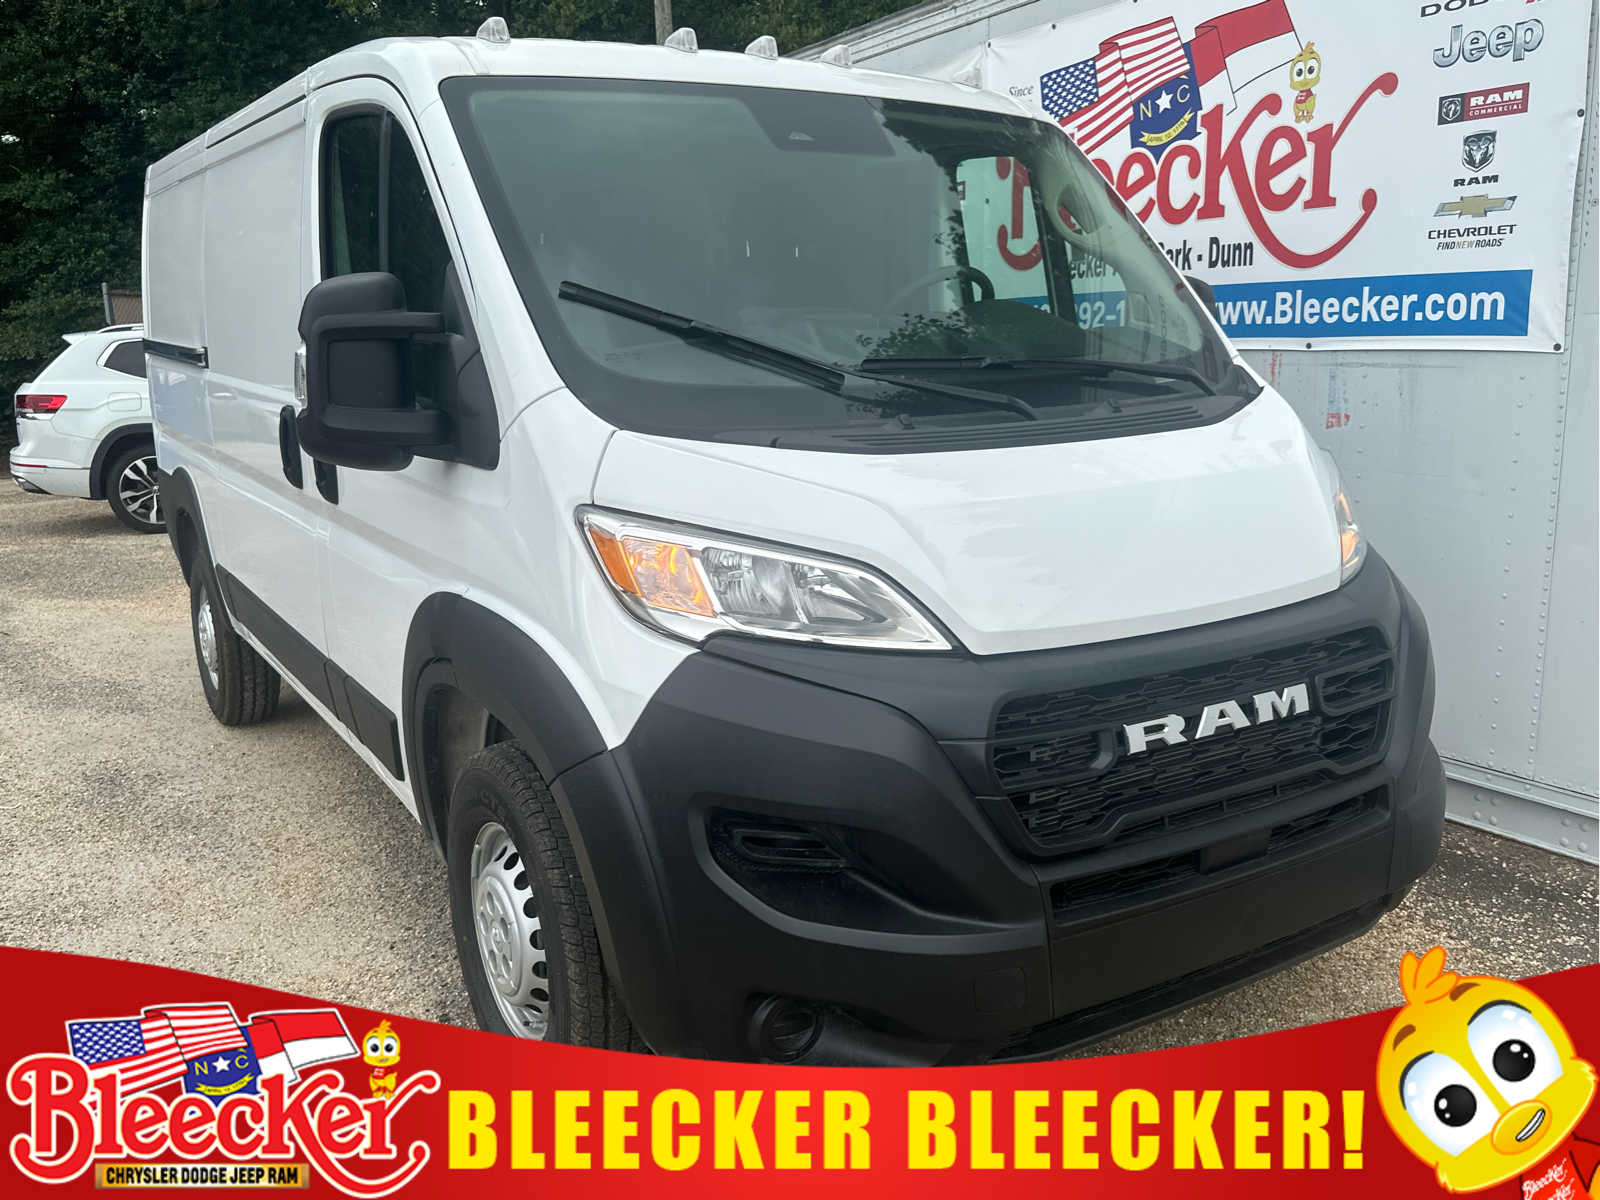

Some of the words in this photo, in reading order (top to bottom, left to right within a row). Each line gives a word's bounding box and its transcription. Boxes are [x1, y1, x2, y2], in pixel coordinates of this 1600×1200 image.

[1432, 18, 1544, 68] Jeep
[1009, 85, 1034, 96] Since
[1139, 101, 1152, 120] N
[1177, 84, 1190, 103] C
[1469, 89, 1523, 107] RAM
[1469, 104, 1523, 117] COMMERCIAL
[1453, 174, 1499, 187] RAM
[1428, 224, 1517, 240] CHEVROLET
[1208, 236, 1254, 269] Dunn
[1215, 286, 1505, 326] ww.Bleecker.com
[1123, 683, 1310, 755] RAM
